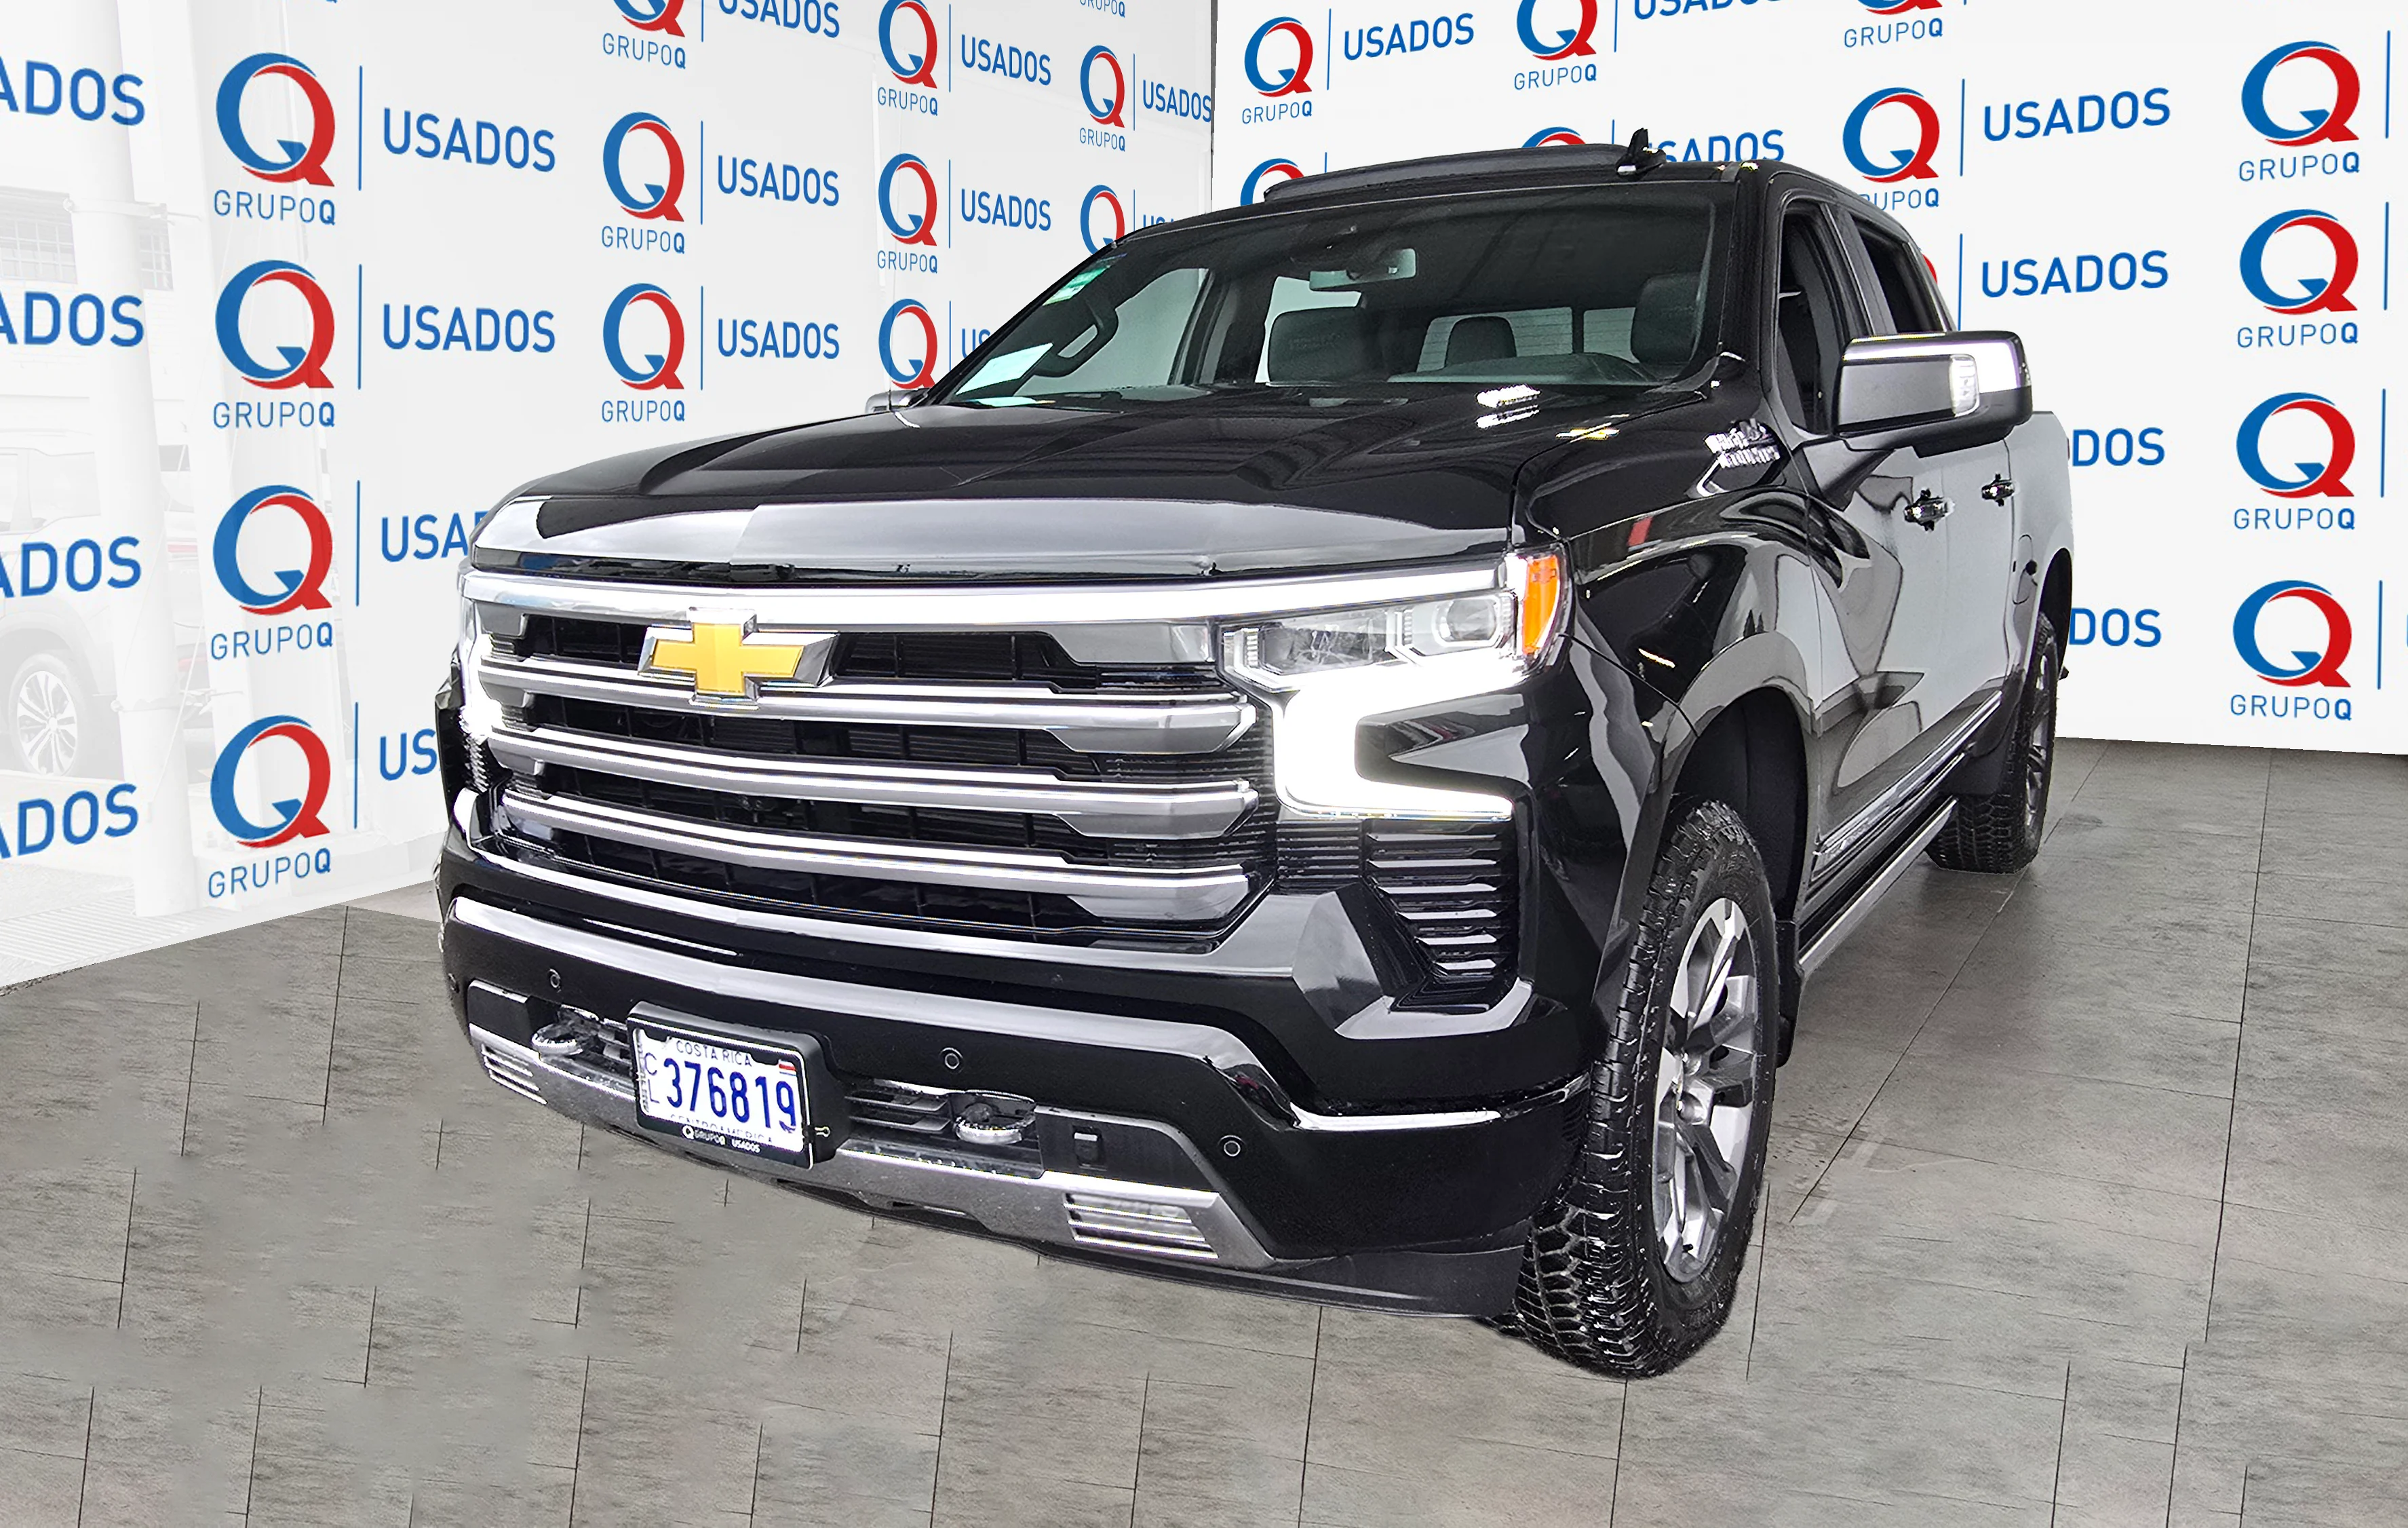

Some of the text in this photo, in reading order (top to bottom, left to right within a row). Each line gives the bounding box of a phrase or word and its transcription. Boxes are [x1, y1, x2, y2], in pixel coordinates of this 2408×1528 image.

[962, 34, 1051, 85] USADOS
[1344, 13, 1474, 60] USADOS
[1143, 79, 1211, 122] USADOS
[1984, 88, 2170, 141] USADOS
[384, 108, 556, 172] USADOS
[1648, 130, 1784, 162] SADOS
[718, 155, 839, 206] USADOS
[961, 189, 1051, 231] USADOS
[1982, 250, 2169, 298] USADOS
[383, 304, 555, 353] USADOS
[718, 319, 839, 359] USADOS
[676, 1040, 752, 1067] COSTA RICA
[663, 1057, 797, 1134] 376819
[731, 1139, 761, 1153] USADOS
